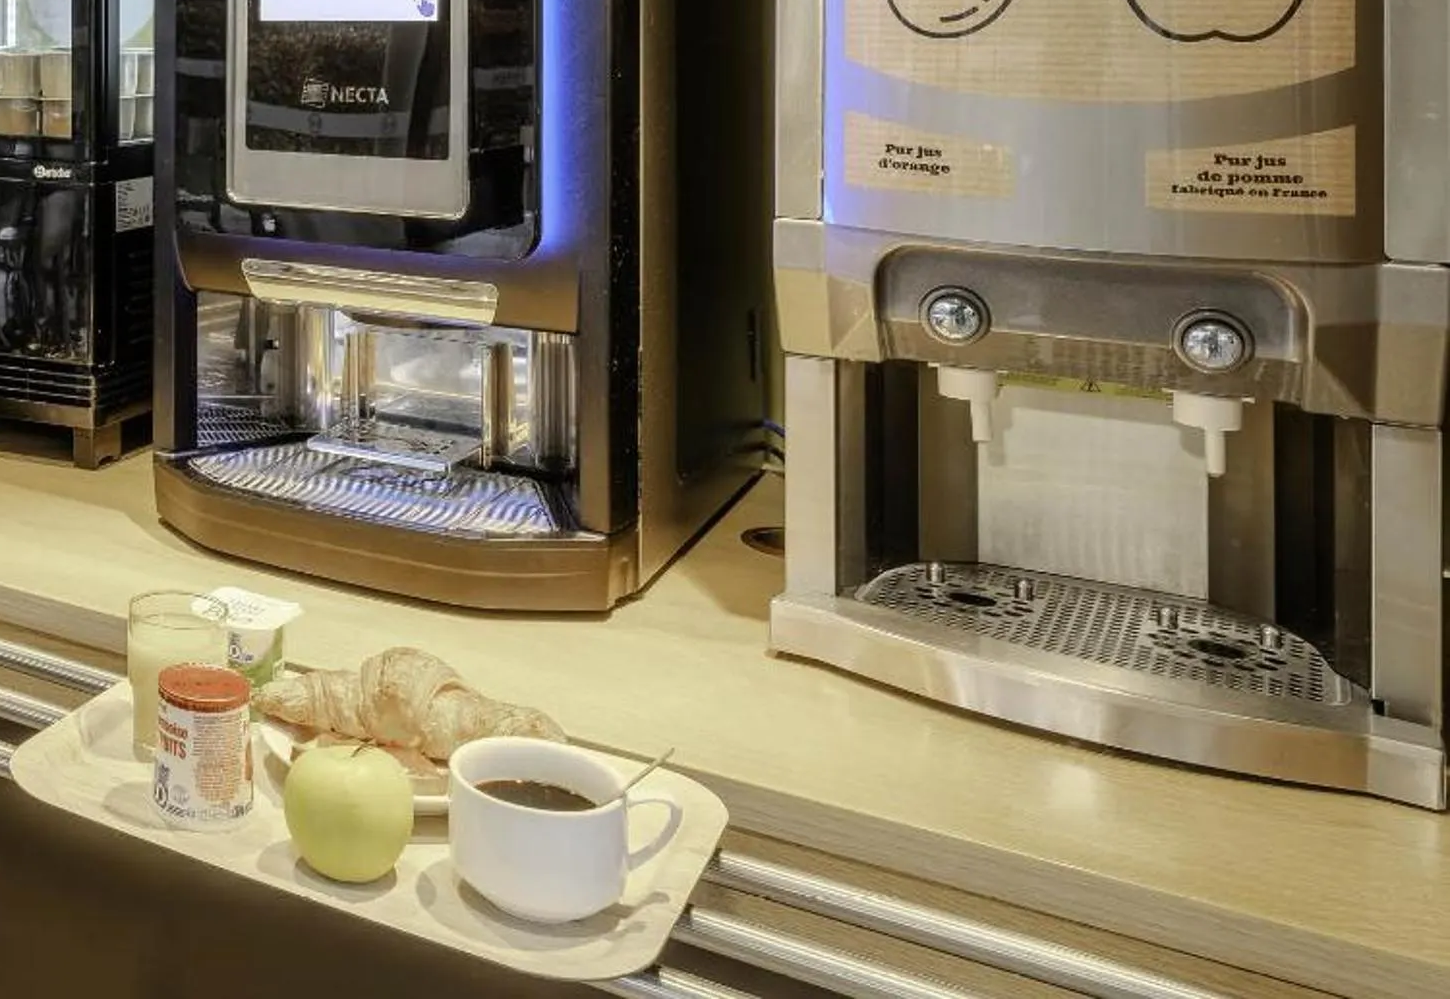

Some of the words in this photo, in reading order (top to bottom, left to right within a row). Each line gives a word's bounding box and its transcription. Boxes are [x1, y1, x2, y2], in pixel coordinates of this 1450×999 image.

[331, 85, 390, 104] NECTA
[885, 143, 913, 155] Pur
[916, 146, 943, 159] jus
[878, 158, 951, 176] d'orange
[1214, 153, 1252, 167] Pur
[1255, 154, 1287, 170] jus
[1197, 170, 1222, 182] de
[1227, 174, 1304, 186] pomme
